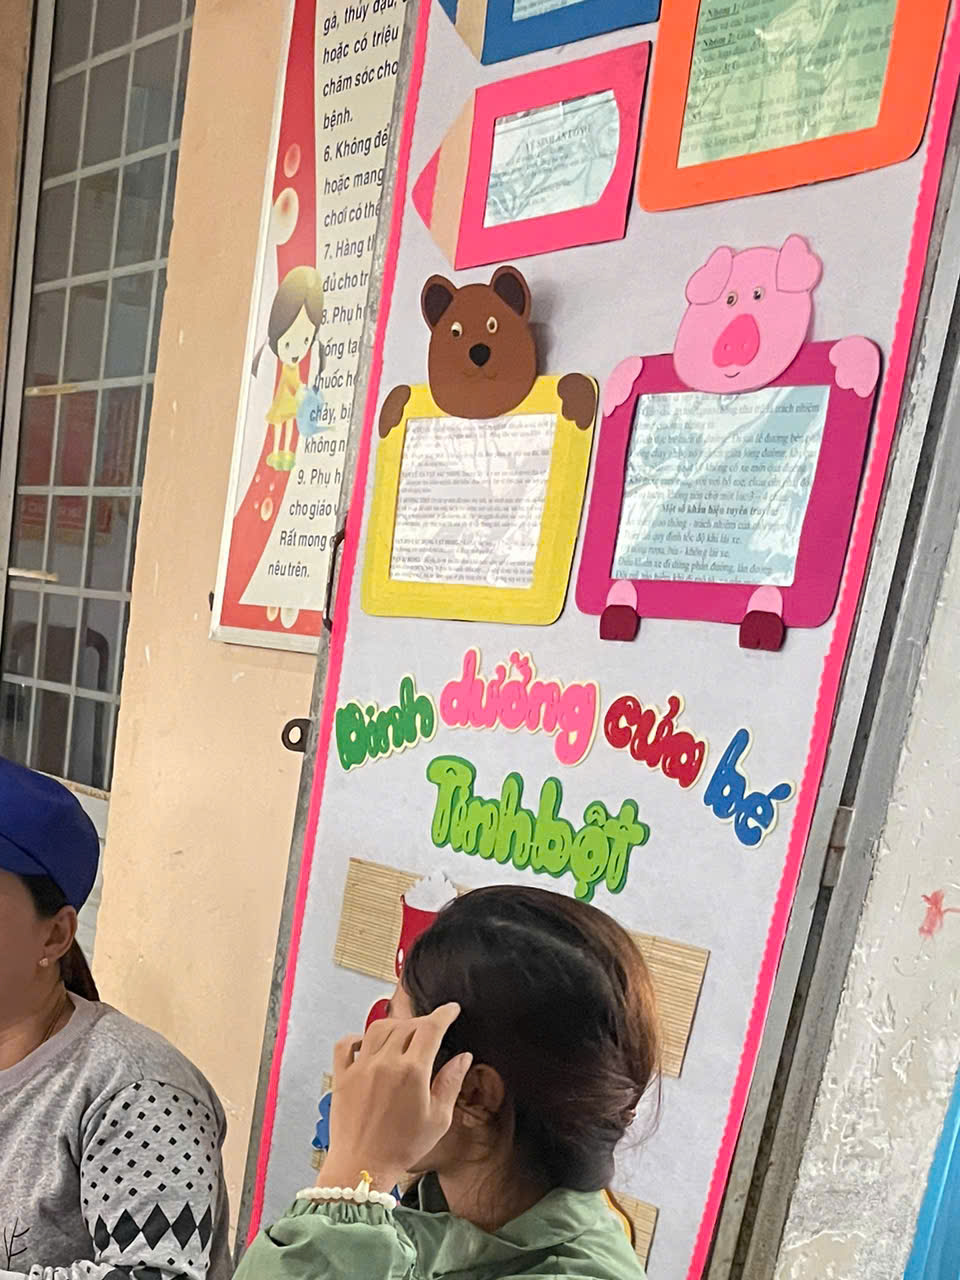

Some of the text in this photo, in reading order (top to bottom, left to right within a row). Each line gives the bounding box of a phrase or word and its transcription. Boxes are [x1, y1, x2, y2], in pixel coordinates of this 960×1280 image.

[323, 24, 399, 64] hoặc có triệu
[323, 60, 399, 97] chăm sóc cho
[323, 107, 353, 131] bệnh.
[324, 145, 332, 162] 6.
[336, 136, 372, 159] Không
[324, 168, 384, 196] hoặc mang
[349, 202, 362, 222] có
[324, 243, 332, 260] 7.
[336, 237, 364, 258] Hàng
[322, 272, 337, 292] đủ
[338, 272, 358, 290] cho
[321, 309, 329, 325] 8.
[332, 305, 353, 325] Phụ
[304, 435, 337, 457] không
[297, 469, 306, 485] 9.
[311, 468, 331, 488] Phụ
[289, 500, 308, 516] cho
[309, 499, 332, 520] giáo
[280, 528, 297, 547] Rất
[298, 534, 327, 552] mong
[268, 560, 310, 578] nêu trên.
[337, 649, 792, 846] Dinh dưỡng của bé
